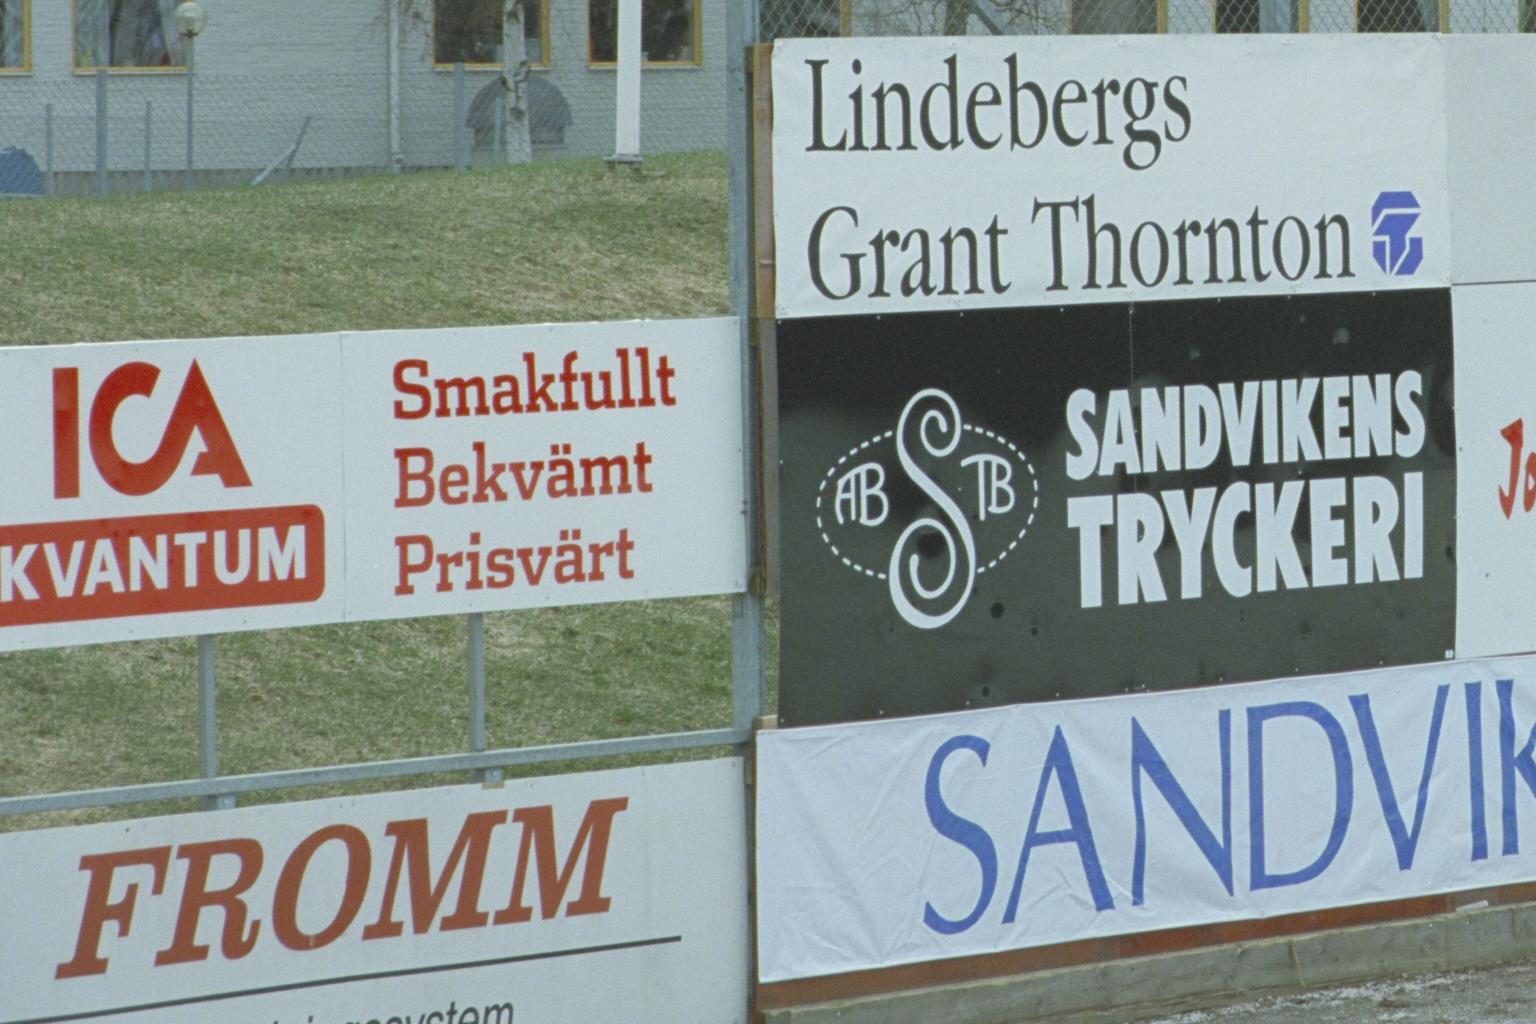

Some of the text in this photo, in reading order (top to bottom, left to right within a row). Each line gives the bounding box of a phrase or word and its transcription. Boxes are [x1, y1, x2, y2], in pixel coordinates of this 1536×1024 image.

[805, 53, 1191, 170] Lindebergs
[808, 194, 1356, 300] Grant Thornton
[53, 358, 253, 499] ICA
[393, 347, 676, 420] Smakfullt
[1066, 370, 1426, 480] SANDVIKENS
[394, 442, 653, 508] Bekvämt
[0, 524, 307, 604] KVANTUM
[394, 528, 635, 596] Prisvärt
[1067, 472, 1424, 609] TRYCKERI
[55, 797, 629, 981] FROMM
